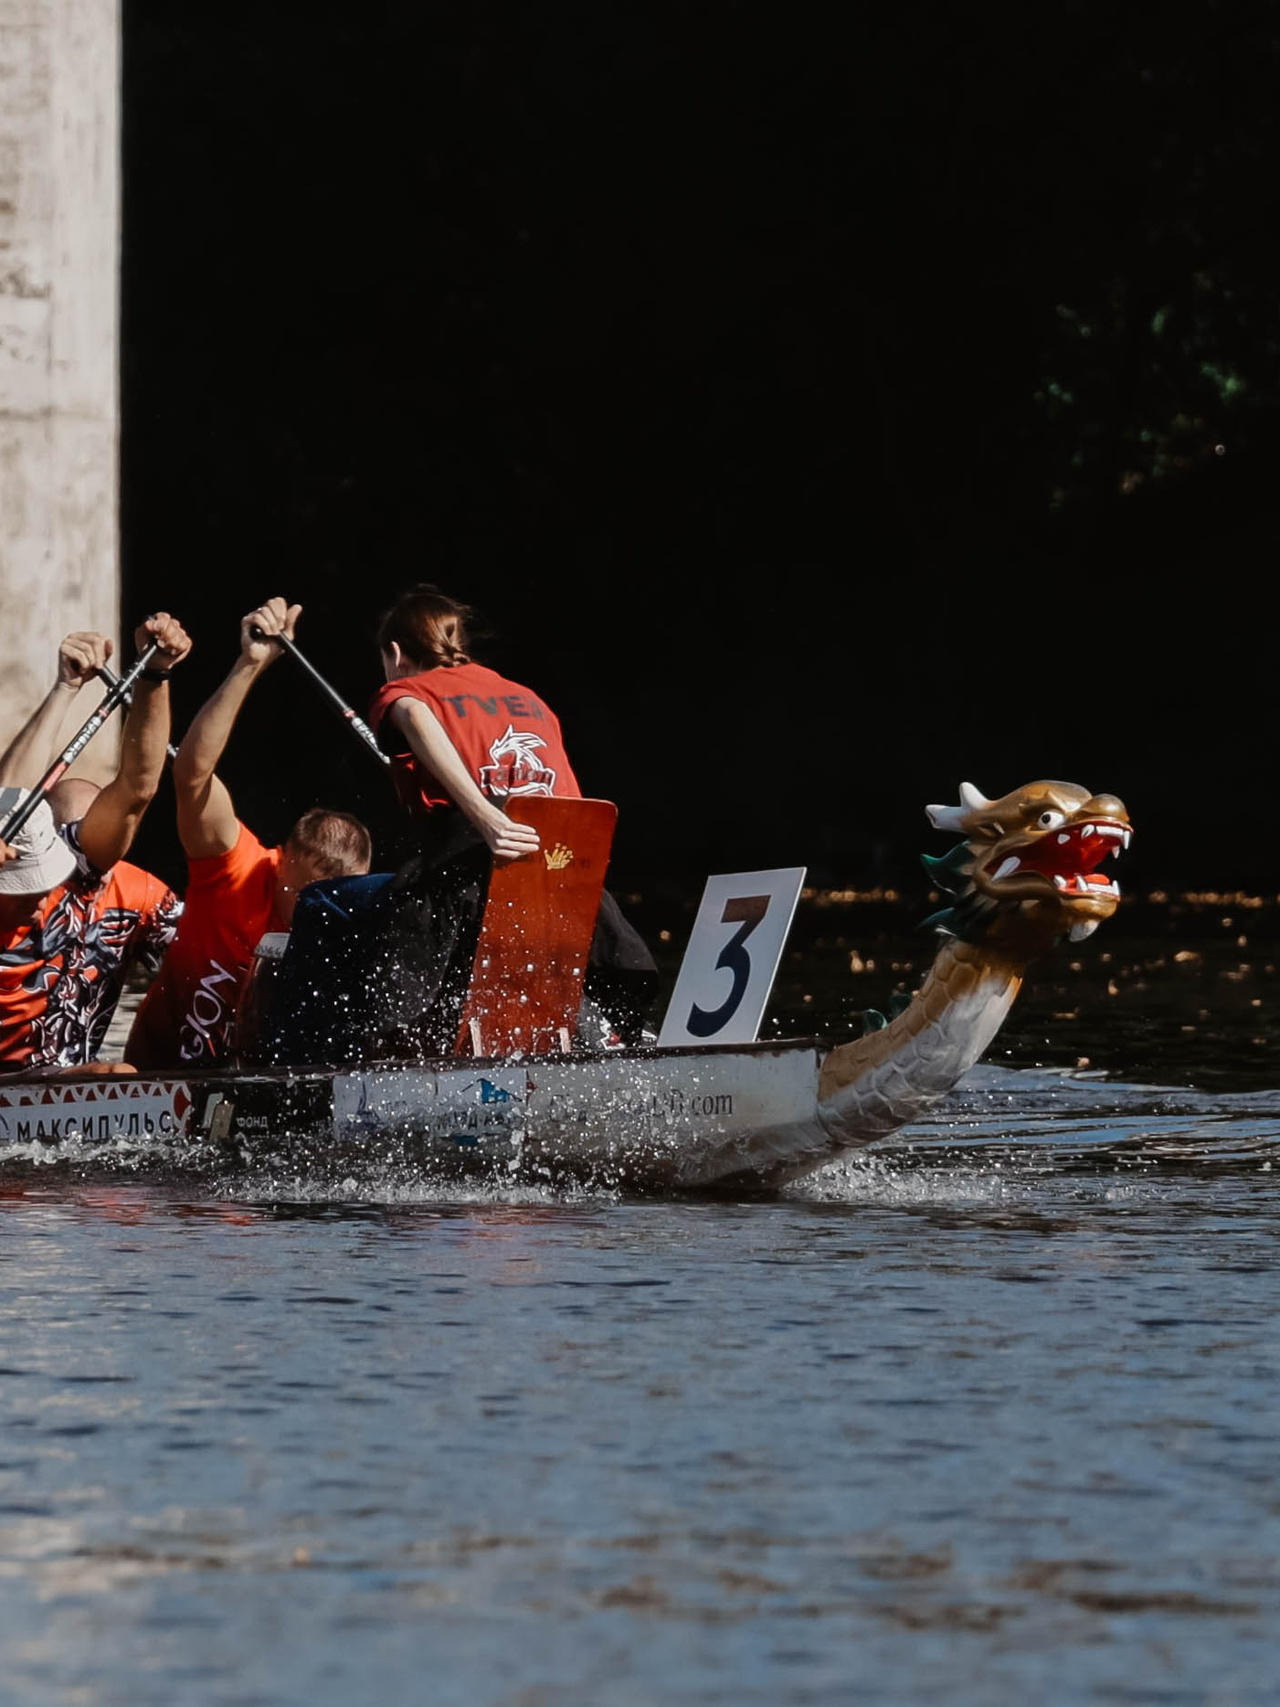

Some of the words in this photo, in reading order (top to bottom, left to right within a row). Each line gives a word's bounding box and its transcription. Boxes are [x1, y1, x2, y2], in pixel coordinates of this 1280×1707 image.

[686, 894, 771, 1037] 3
[17, 1110, 172, 1142] МАКСИПУЛЬС
[236, 1116, 269, 1129] ФОНД
